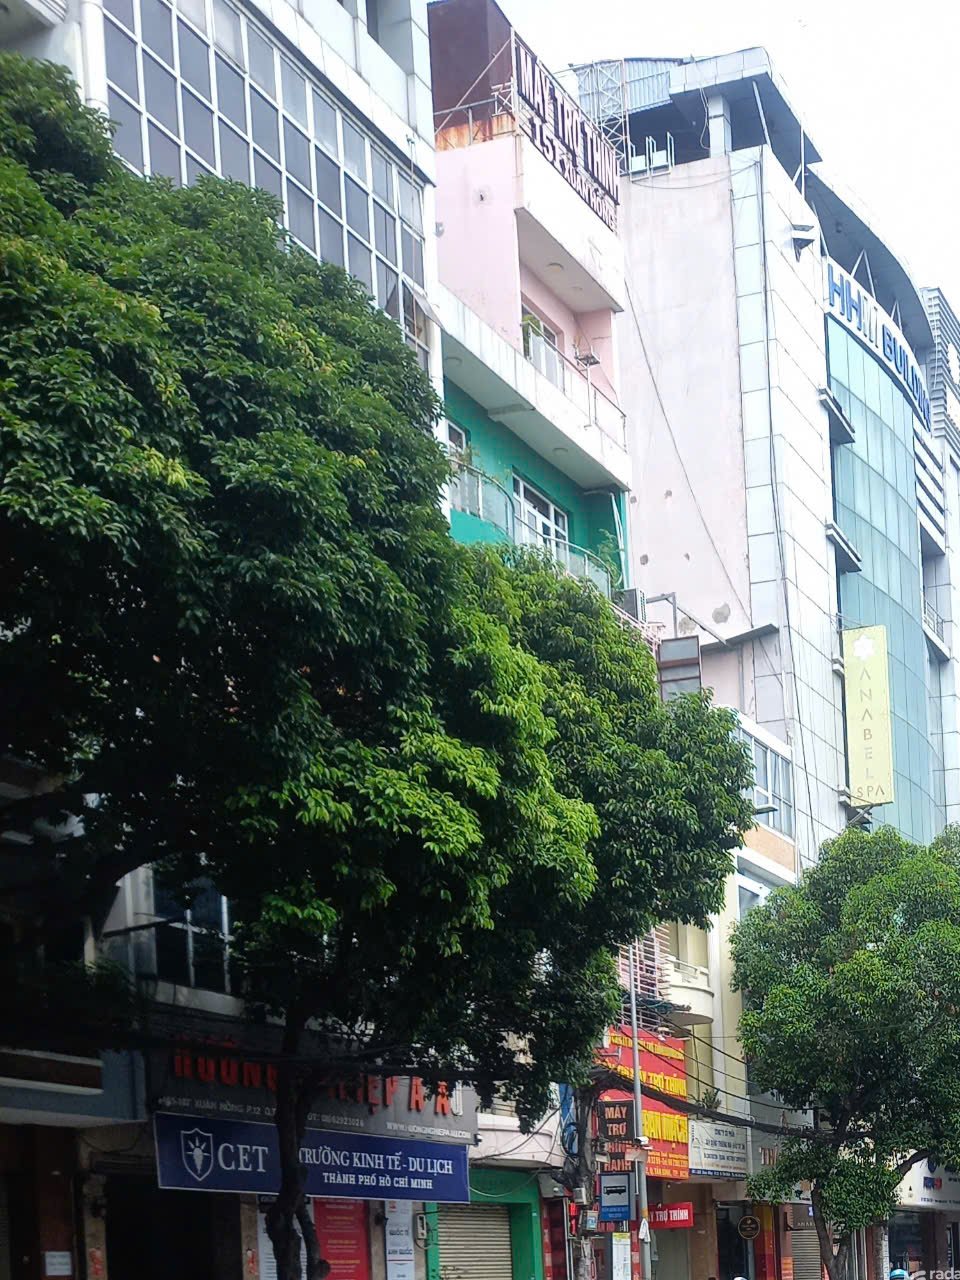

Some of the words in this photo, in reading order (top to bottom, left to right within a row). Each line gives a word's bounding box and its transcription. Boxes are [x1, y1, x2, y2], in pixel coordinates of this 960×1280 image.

[857, 783, 886, 798] SPA
[604, 1103, 627, 1119] MÁY
[606, 1122, 627, 1137] TRỢ
[218, 1143, 269, 1172] CET
[299, 1145, 350, 1167] TRƯỜNG
[352, 1152, 384, 1169] KINH
[386, 1151, 402, 1171] TẾ
[408, 1157, 425, 1173] DU
[427, 1159, 454, 1177] LỊCH
[323, 1172, 356, 1185] THÀNH
[358, 1173, 376, 1187] PHỐ
[379, 1175, 391, 1187] HỒ
[394, 1175, 409, 1188] CHÍ
[411, 1179, 432, 1189] MINH
[669, 1207, 688, 1220] THÍNH
